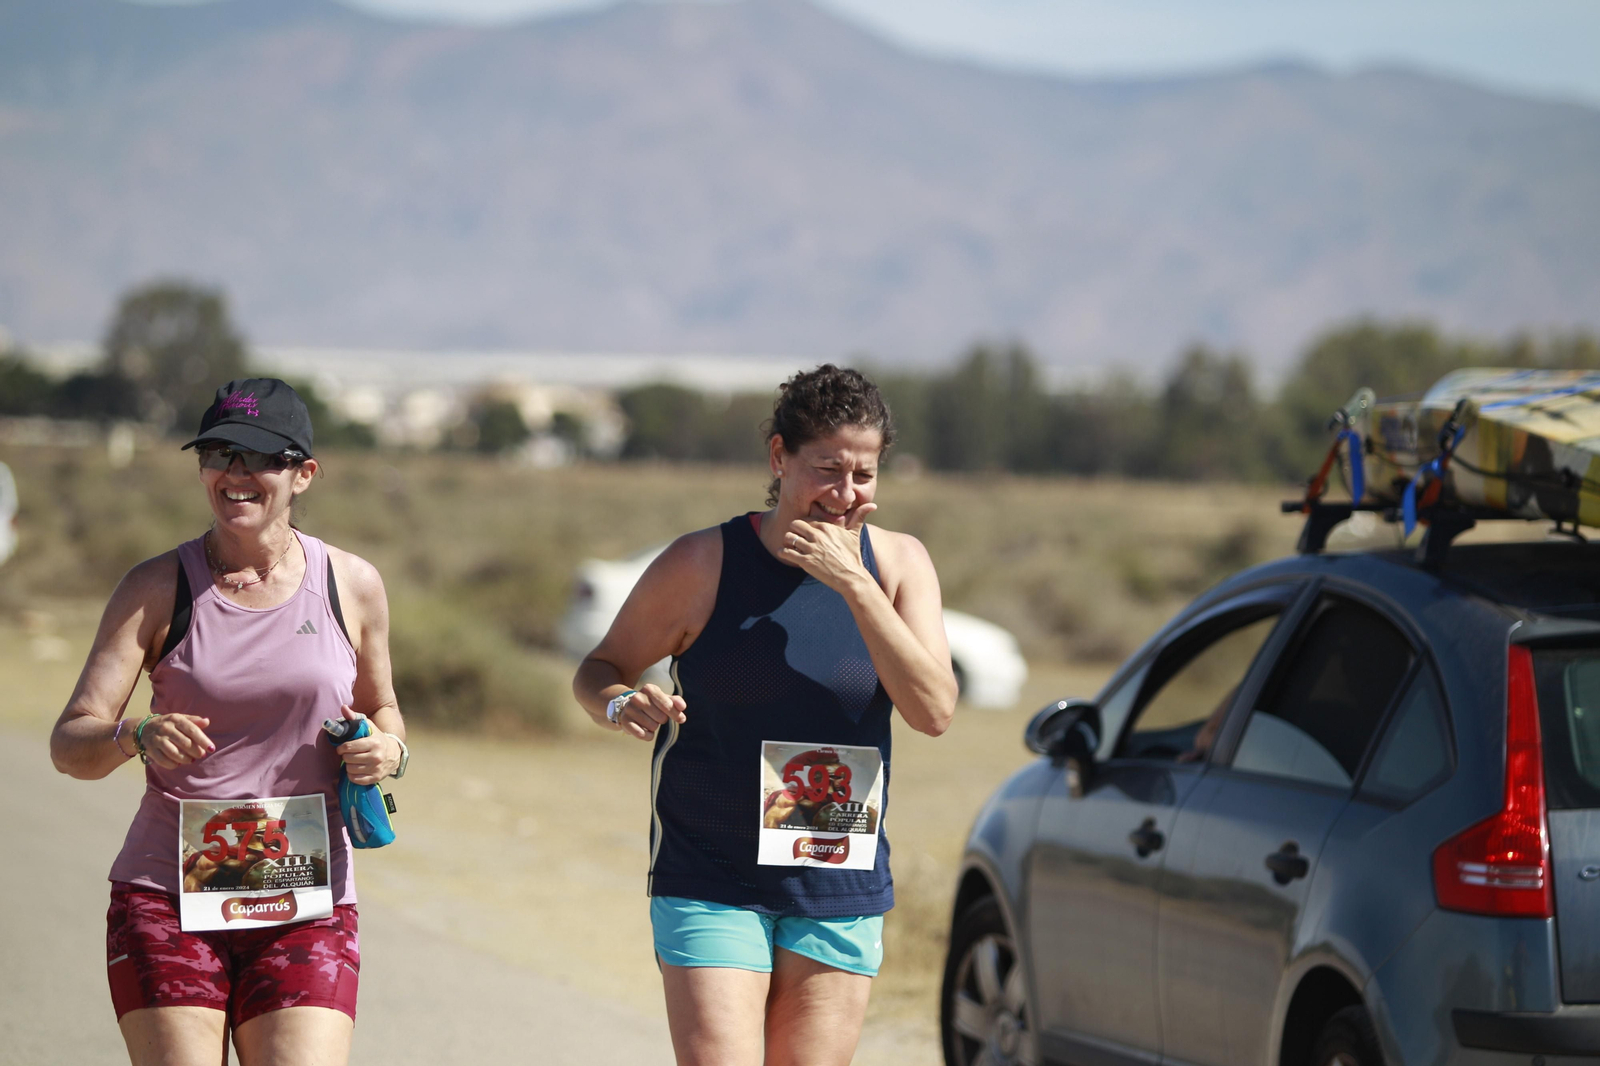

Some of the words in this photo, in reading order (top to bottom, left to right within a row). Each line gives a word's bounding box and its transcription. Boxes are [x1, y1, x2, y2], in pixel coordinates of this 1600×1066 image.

[782, 764, 852, 804] 593
[831, 801, 868, 813] XIII
[203, 820, 289, 862] 575
[263, 855, 313, 868] XIII
[263, 871, 313, 879] POPULAR
[281, 880, 314, 888] ALQUIÁN
